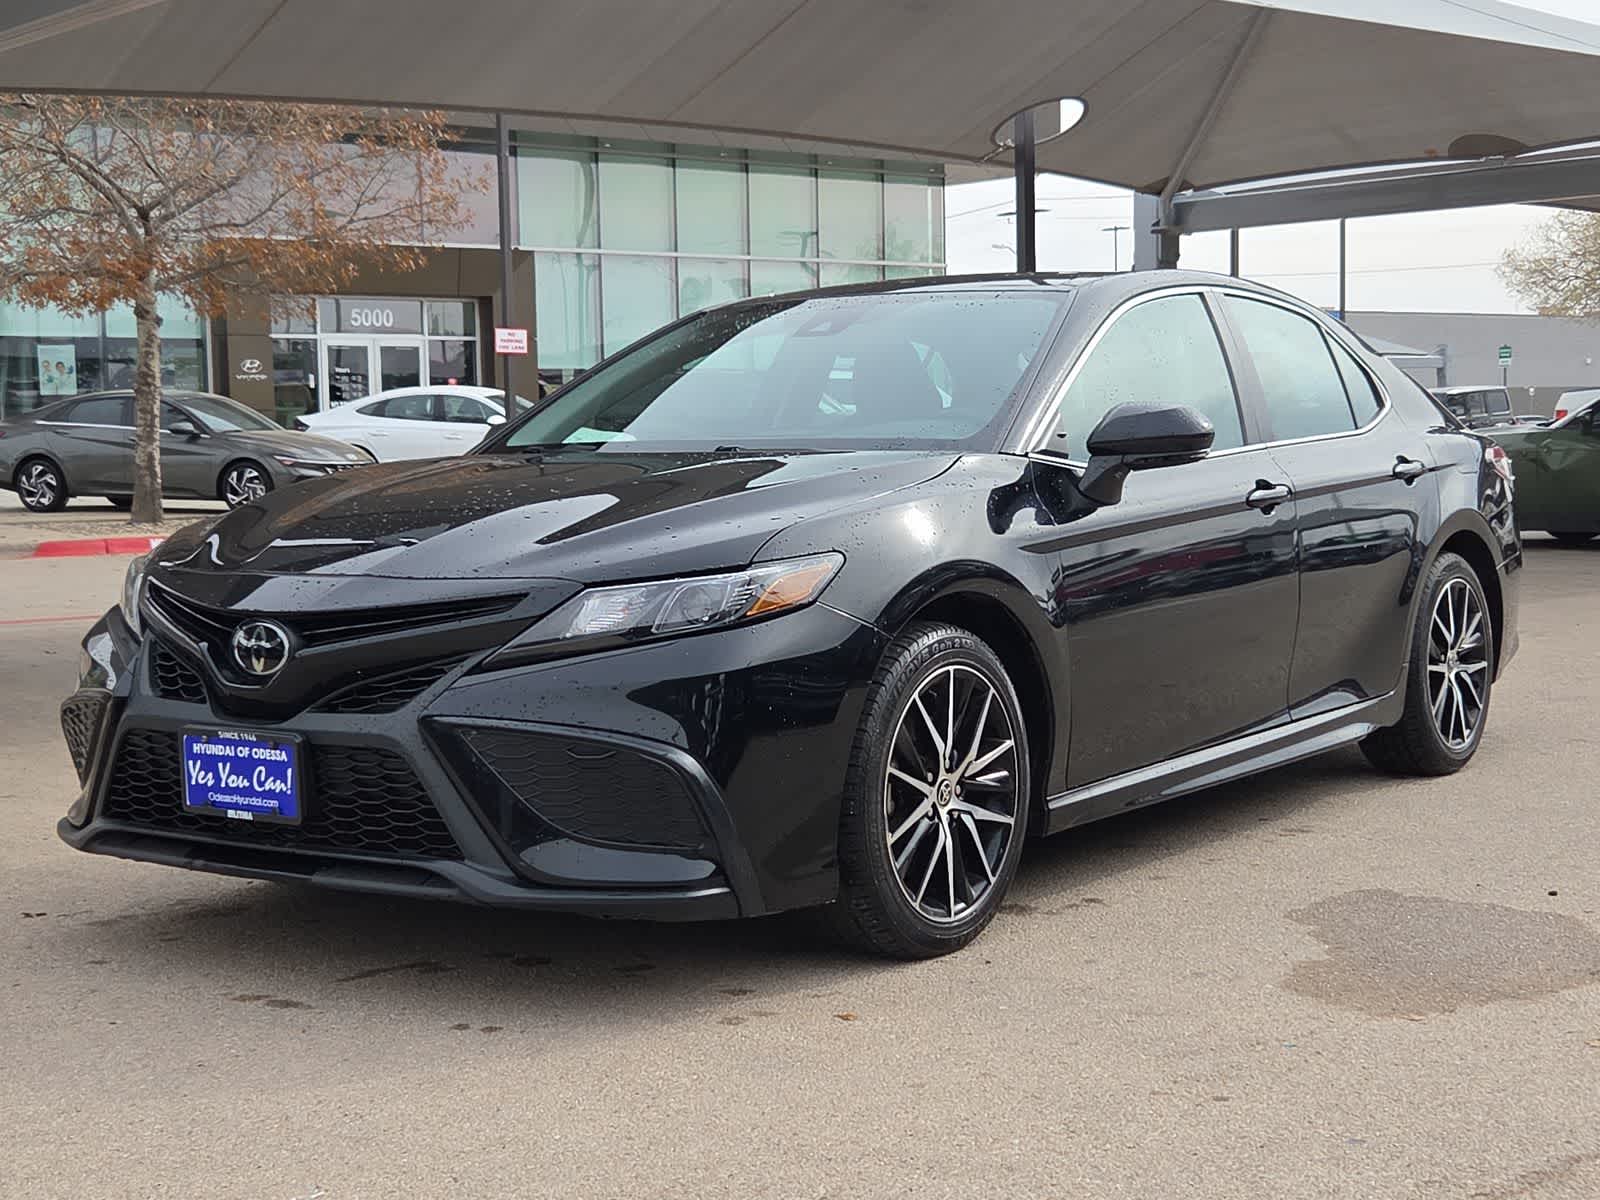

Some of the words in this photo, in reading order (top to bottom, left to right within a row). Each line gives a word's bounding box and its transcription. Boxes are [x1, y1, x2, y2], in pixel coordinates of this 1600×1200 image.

[351, 308, 393, 328] 5000
[193, 743, 235, 756] HYUNDAI
[236, 746, 250, 758] OF
[251, 748, 288, 762] ODESSA
[188, 760, 215, 787] Yes
[218, 762, 250, 788] You
[253, 766, 292, 795] Can!
